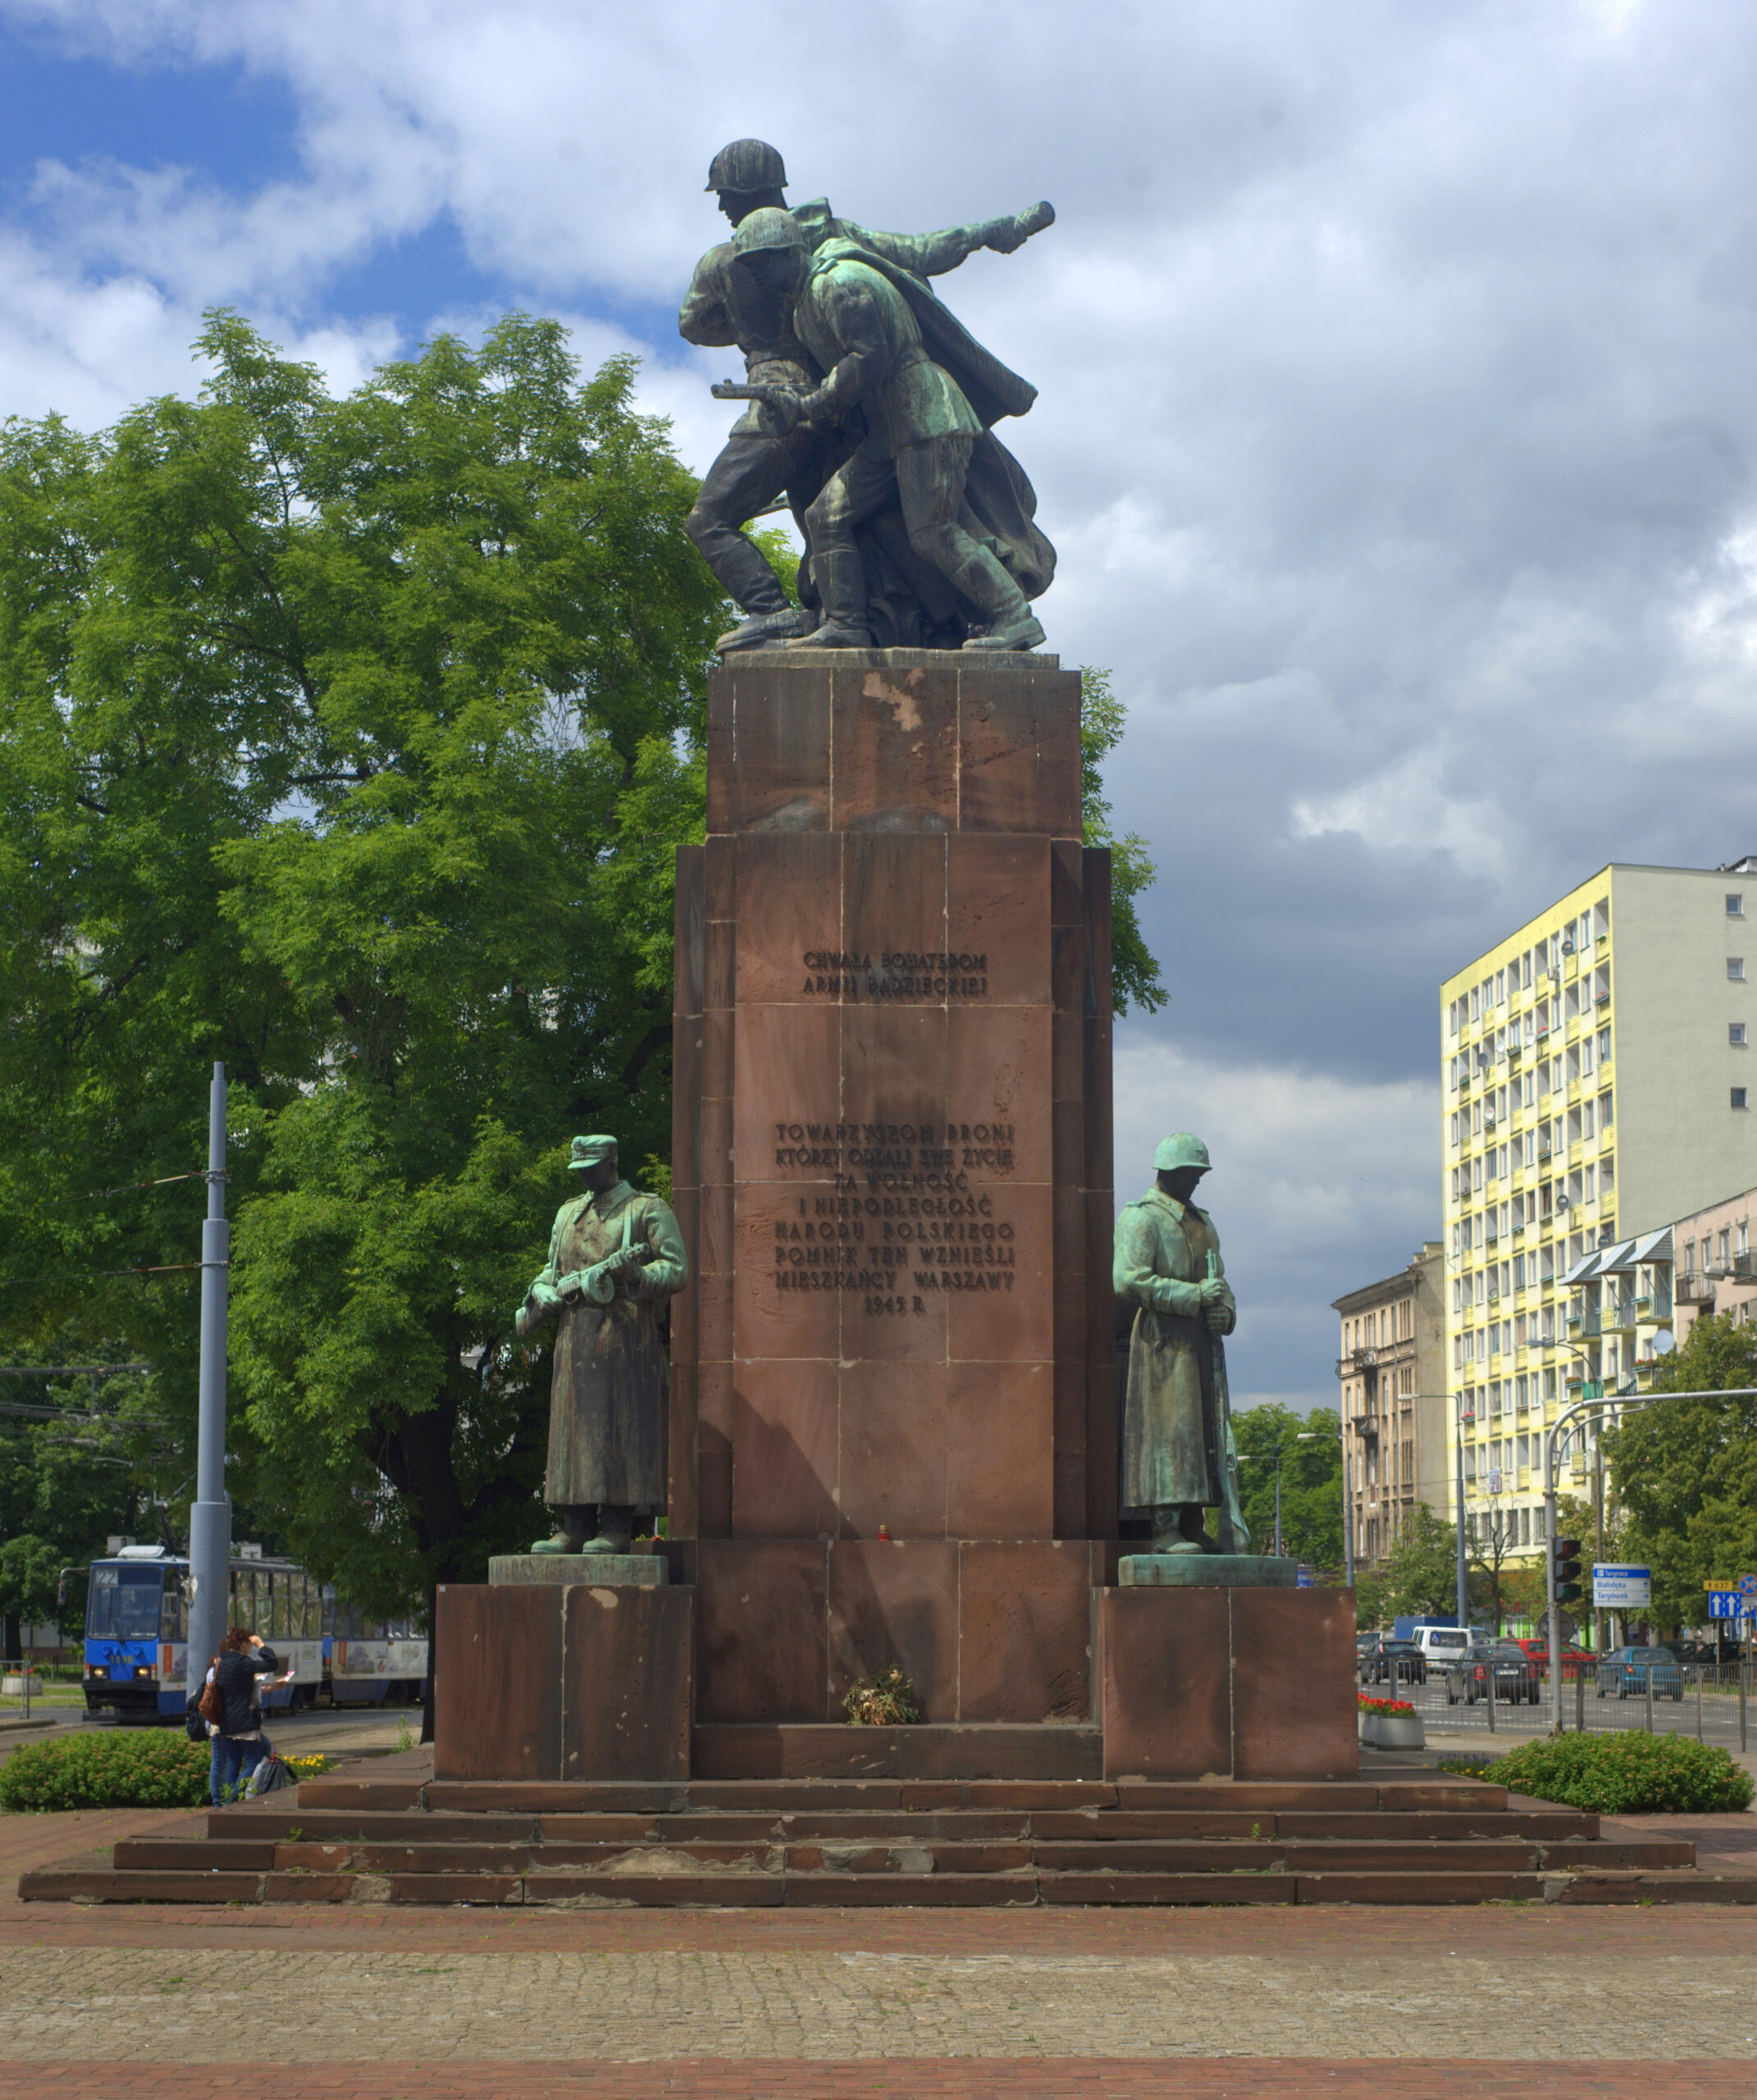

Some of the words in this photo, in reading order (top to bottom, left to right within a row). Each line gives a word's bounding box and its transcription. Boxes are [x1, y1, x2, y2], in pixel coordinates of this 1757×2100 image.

[803, 952, 873, 969] CHWAŁA
[881, 952, 987, 970] BOHATEROM
[803, 976, 856, 993] ARMII
[869, 977, 987, 993] RADZIECKIEJ
[776, 1124, 933, 1141] TOWARZYSZOM
[947, 1125, 1014, 1141] BRONI
[776, 1144, 842, 1165] KTÓRZY
[848, 1148, 910, 1166] ODDALI
[920, 1148, 954, 1166] SWE
[962, 1146, 1013, 1166] ŻYCIE
[834, 1173, 858, 1189] ZA
[865, 1169, 970, 1189] WOLNOŚĆ
[798, 1198, 805, 1214] I
[815, 1194, 993, 1215] NIEPODLEGŁOŚĆ
[775, 1222, 865, 1239] NARODU
[883, 1222, 1014, 1239] POLSKIEGO
[775, 1247, 857, 1263] POMNIK
[868, 1247, 907, 1263] TEN
[920, 1244, 1014, 1263] WZNIEŚLI
[775, 1267, 897, 1288] MIESZKAŃCY
[913, 1271, 1015, 1288] WARSZAWY
[865, 1296, 905, 1312] 1945
[97, 1568, 116, 1584] 22
[1597, 1581, 1627, 1590] Białołęka
[1598, 1591, 1628, 1601] Targówek
